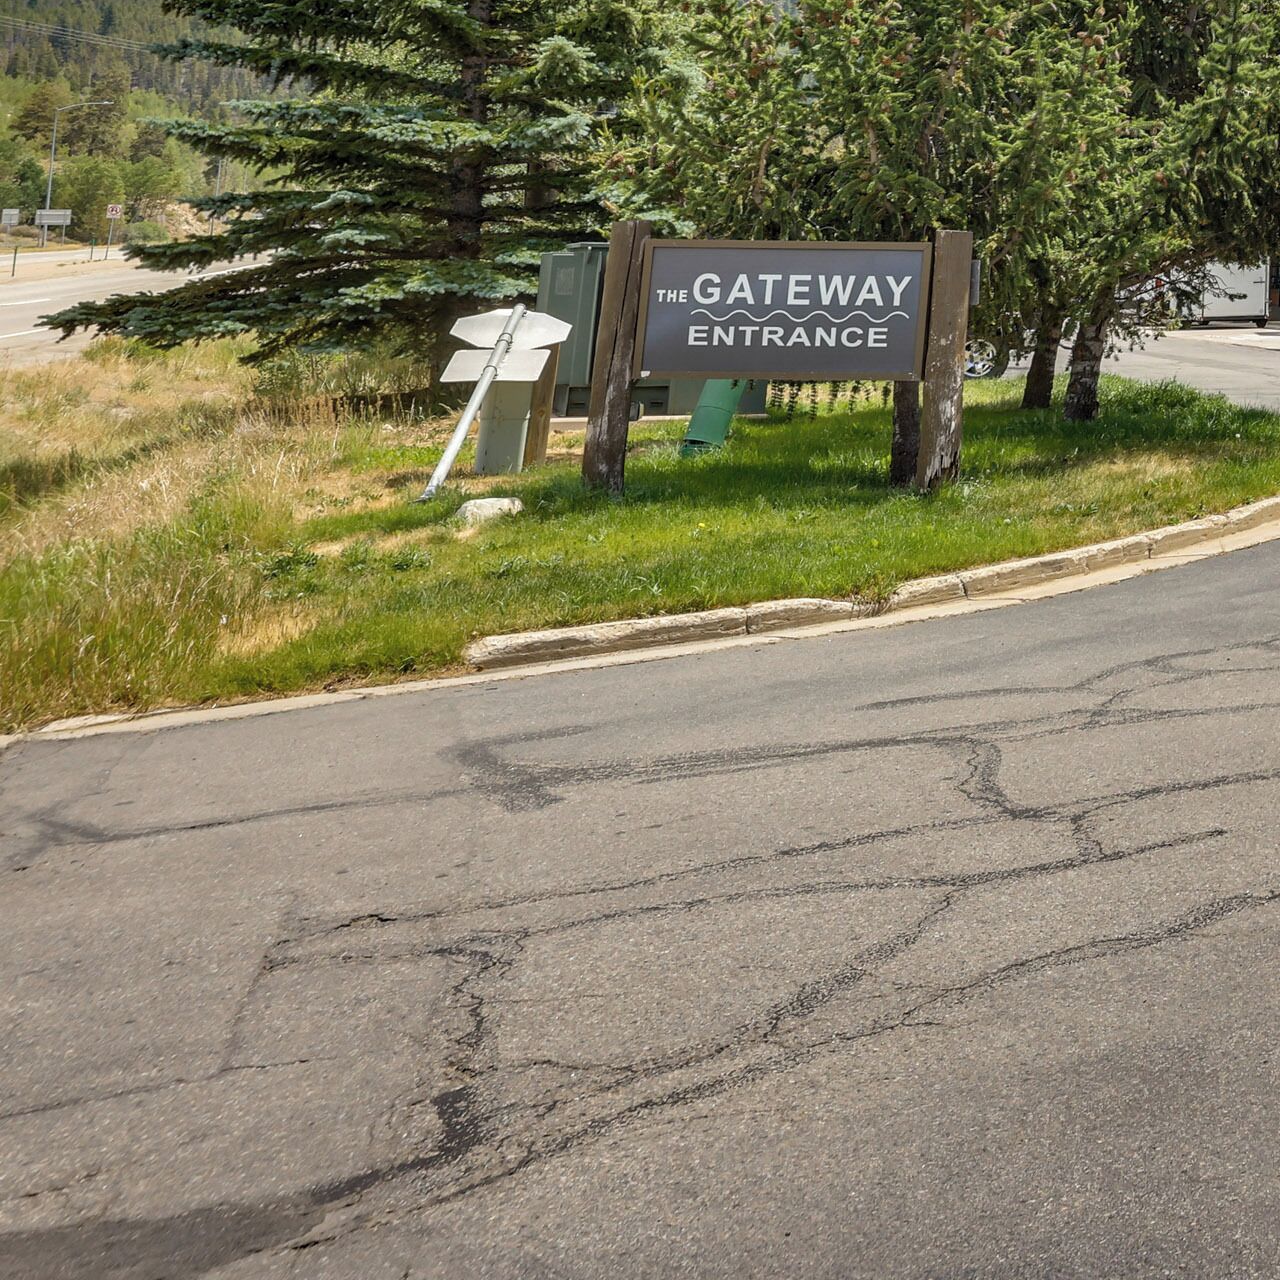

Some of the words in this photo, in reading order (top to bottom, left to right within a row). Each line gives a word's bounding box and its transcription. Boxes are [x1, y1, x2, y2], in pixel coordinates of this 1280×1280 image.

[656, 289, 688, 303] THE
[692, 272, 912, 307] GATEWAY
[687, 325, 889, 348] ENTRANCE
